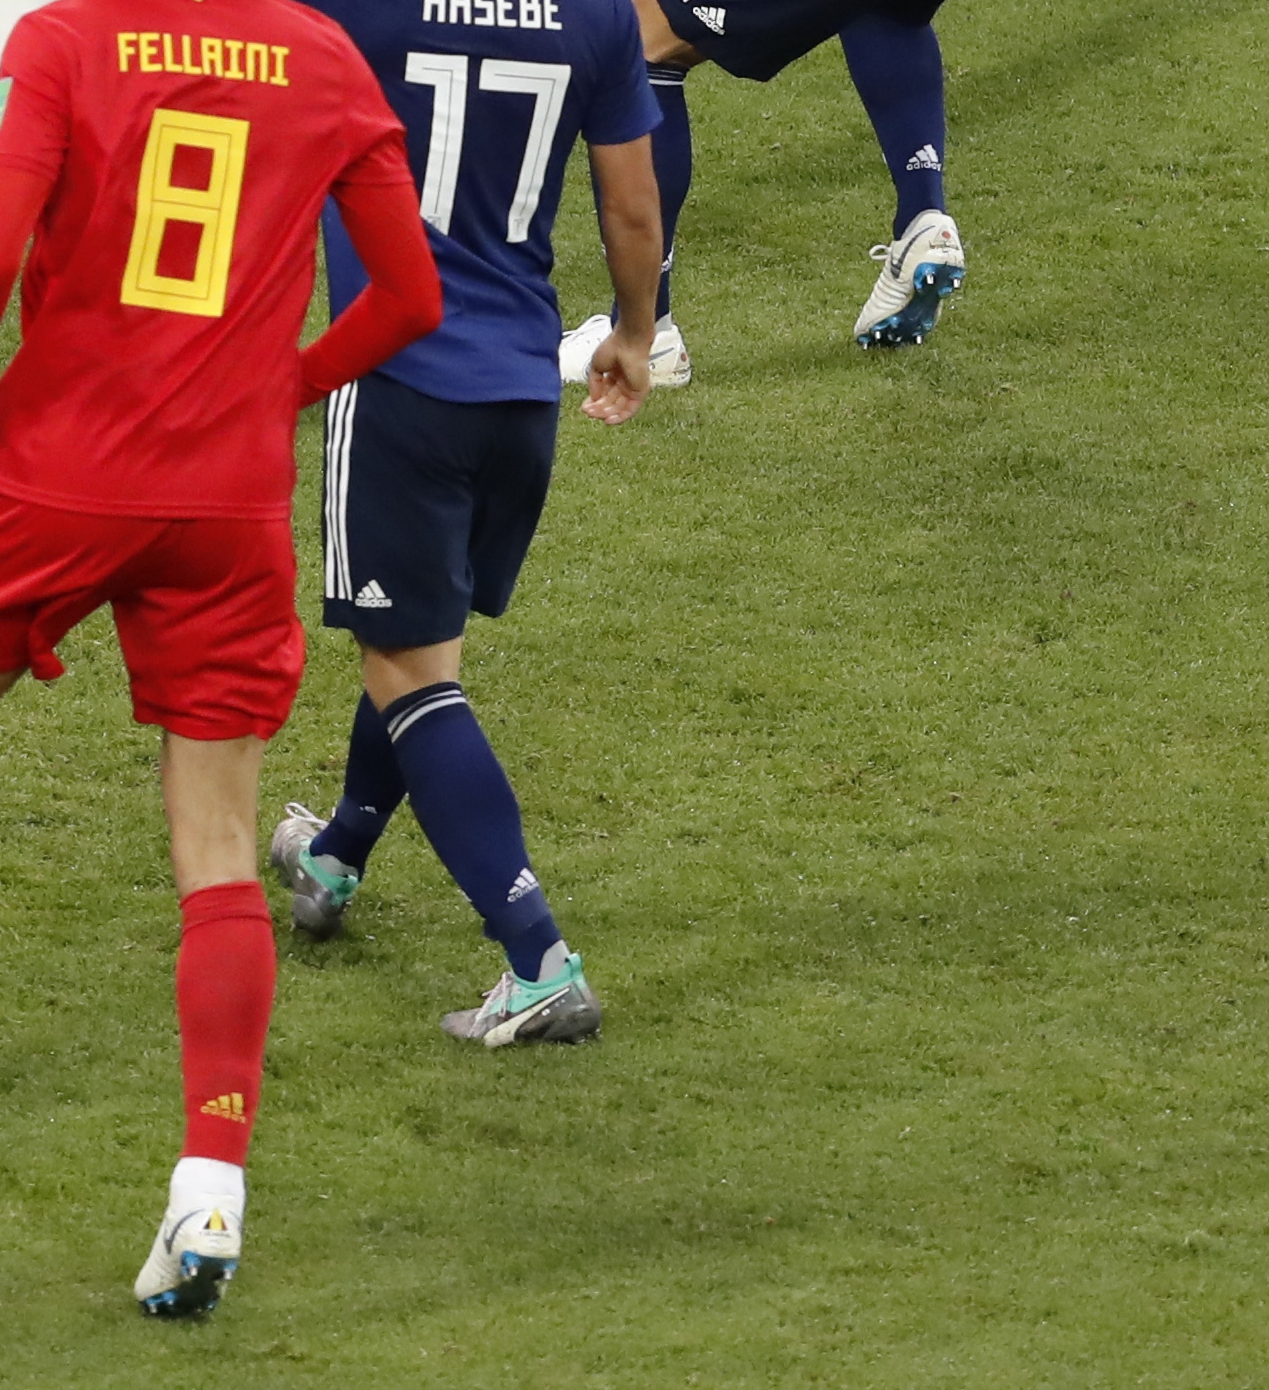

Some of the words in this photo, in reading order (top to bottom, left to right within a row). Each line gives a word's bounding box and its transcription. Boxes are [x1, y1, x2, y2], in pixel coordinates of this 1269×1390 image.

[117, 32, 290, 87] FELLAINI
[404, 51, 572, 243] 17
[120, 108, 250, 318] 8
